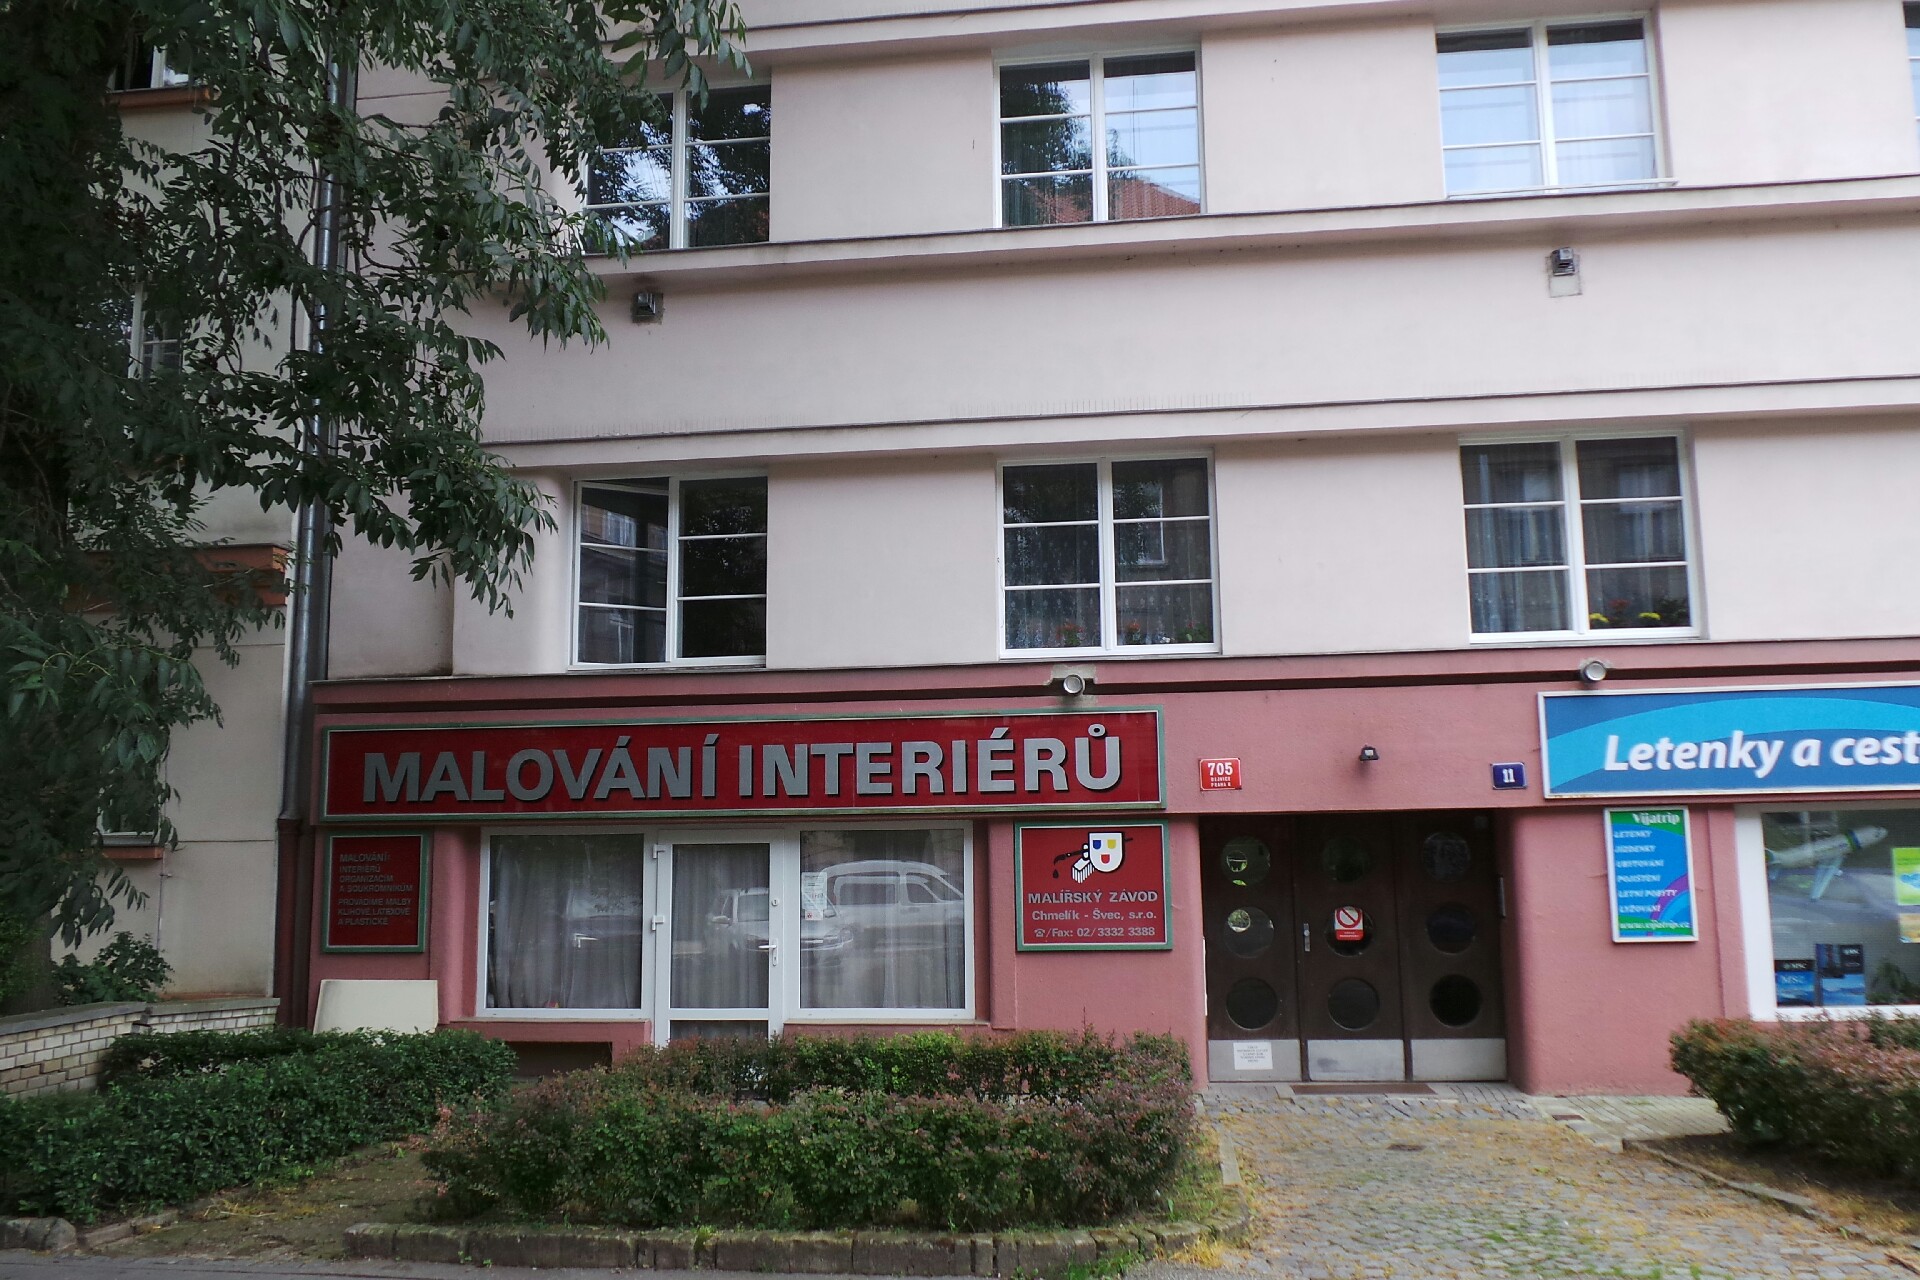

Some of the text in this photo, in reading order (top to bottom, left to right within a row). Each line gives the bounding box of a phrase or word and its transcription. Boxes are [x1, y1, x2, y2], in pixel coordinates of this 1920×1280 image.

[1604, 730, 1784, 779] Letenky
[1791, 738, 1821, 767] a
[363, 723, 1120, 803] MALOVÁNÍ INTERIÉRŮ
[1207, 762, 1233, 776] 705
[1502, 768, 1515, 783] 11
[1028, 888, 1158, 904] MALÍŘSKÝ ZÁVOD
[1032, 909, 1079, 921] Chmelík
[1092, 907, 1124, 921] Švec,
[1128, 910, 1157, 919] s.r.o.
[1128, 927, 1155, 936] 3388
